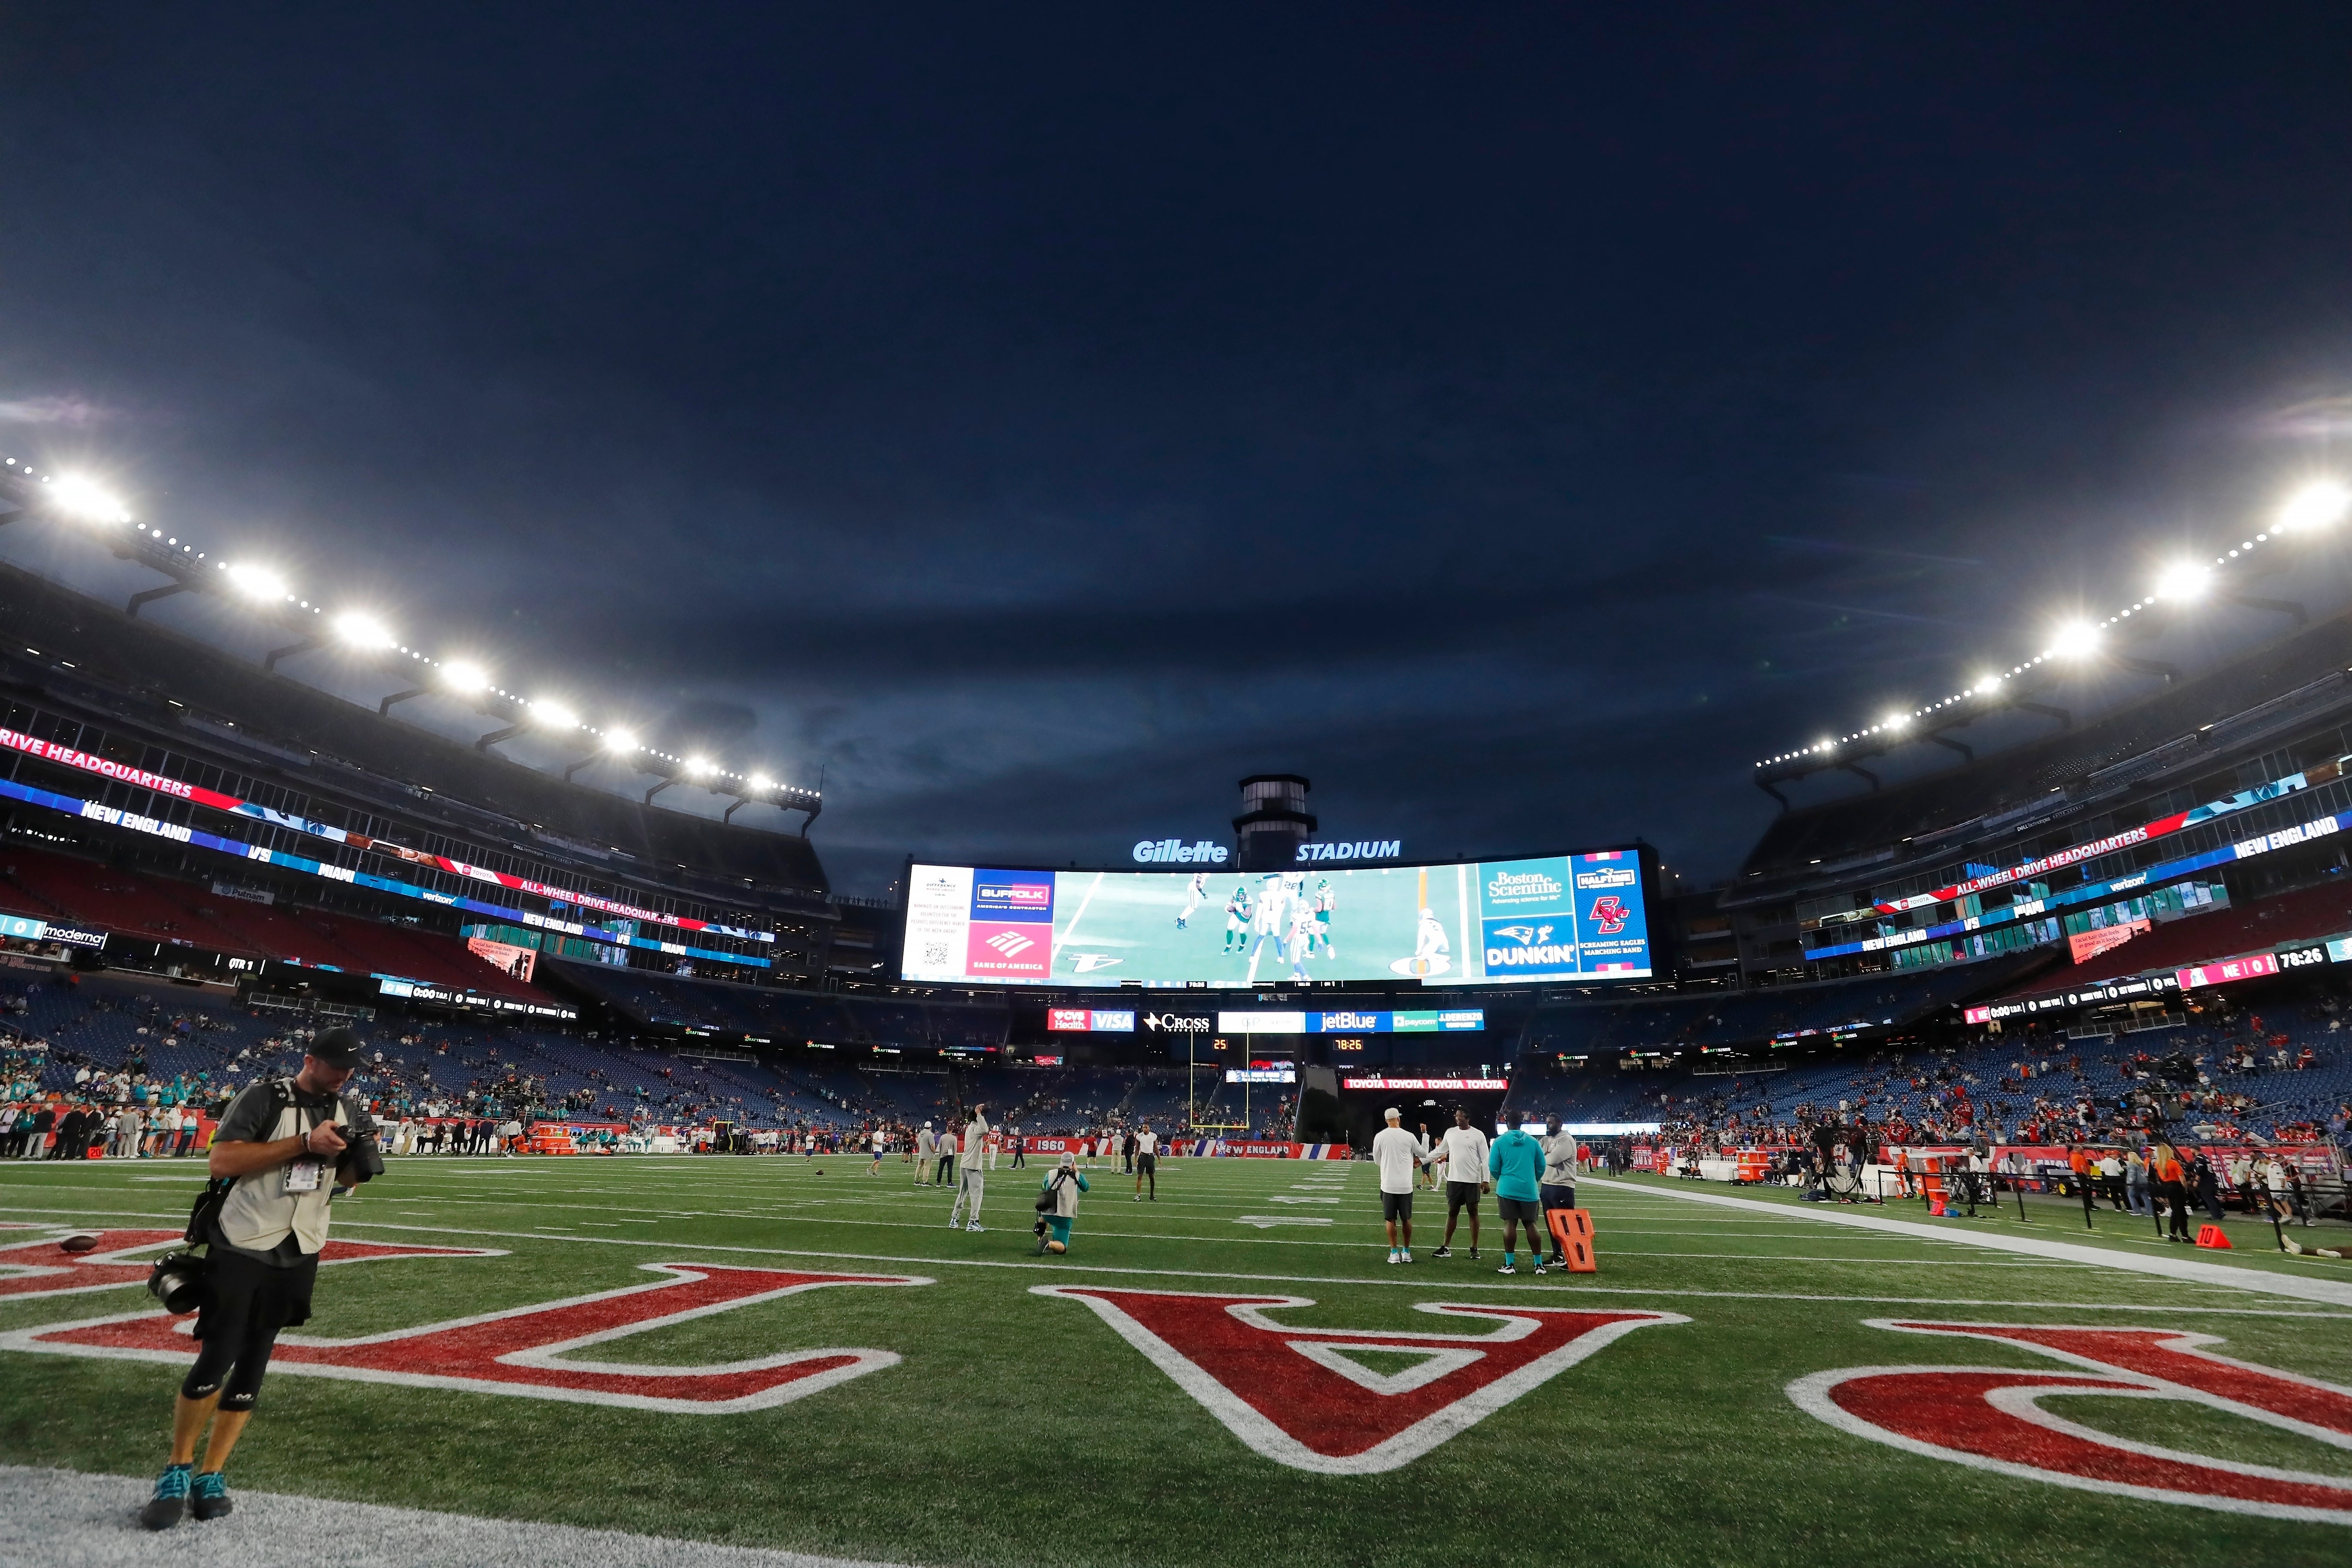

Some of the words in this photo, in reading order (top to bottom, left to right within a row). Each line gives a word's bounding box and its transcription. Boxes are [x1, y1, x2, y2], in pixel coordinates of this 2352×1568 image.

[0, 729, 45, 755] RIVE
[46, 744, 192, 798] HEADQUARTERS
[80, 802, 123, 824] NEW
[120, 812, 192, 842] ENGLAND
[2235, 839, 2269, 859] NEW
[2269, 816, 2340, 851] ENGLAND
[250, 845, 270, 862] VS
[1133, 839, 1228, 863] Gillette
[1295, 840, 1401, 861] STADIUM
[1957, 869, 2014, 896] ALL-WHEEL
[2015, 858, 2049, 879] DRIVE
[2049, 827, 2148, 868] HEADQUARTERS
[318, 863, 355, 883] MIAMI
[473, 870, 492, 879] TOYOTA
[1497, 872, 1543, 885] Boston
[1580, 873, 1631, 885] HALFTIME
[1488, 877, 1562, 897] Scientific
[2110, 877, 2143, 892] verizon
[232, 888, 265, 901] Putnam
[423, 891, 451, 905] verizon
[520, 880, 576, 903] ALL-WHEEL
[578, 894, 605, 910] DRIVE
[981, 889, 1043, 899] SUFFOLK
[1910, 897, 1929, 905] TOYOTA
[2014, 900, 2045, 919] MIAMI
[14, 921, 27, 934] 0
[44, 926, 101, 943] moderna
[523, 913, 545, 927] NEW
[544, 917, 584, 935] ENGLAND
[616, 934, 629, 944] VS
[661, 942, 686, 955] MIAMI
[1862, 938, 1886, 952] NEW
[1885, 930, 1927, 947] ENGLAND
[1964, 918, 1978, 931] VS
[1487, 945, 1575, 966] DUNKIN'
[2222, 963, 2240, 978] NE
[2252, 959, 2263, 973] 0
[2280, 948, 2323, 968] 78:26
[229, 958, 245, 969] QTR
[248, 961, 253, 970] 1
[413, 987, 435, 999] 0:00
[455, 994, 463, 1003] 0
[494, 1000, 502, 1009] 0
[528, 1005, 535, 1014] 0
[561, 1010, 567, 1018] 0
[1977, 1011, 1989, 1020] NE
[1991, 1005, 2010, 1018] 0:00
[2028, 1001, 2037, 1011] 0
[2068, 994, 2078, 1005] 0
[2108, 986, 2118, 998] 0
[2153, 978, 2163, 990] 0
[1064, 1012, 1085, 1020] CVS
[1093, 1014, 1132, 1029] VISA
[1161, 1014, 1210, 1029] CROSS
[1320, 1012, 1375, 1032] jetBlue
[1405, 1019, 1436, 1027] paycom
[1214, 1039, 1226, 1049] 25
[1335, 1039, 1362, 1050] 78:26
[1348, 1079, 1385, 1089] TOYOTA
[1387, 1079, 1424, 1089] TOYOTA
[1427, 1079, 1463, 1089] TOYOTA
[1466, 1079, 1504, 1089] TOYOTA
[90, 1148, 101, 1157] 20
[1037, 1140, 1065, 1151] 1960
[1246, 1145, 1289, 1155] ENGLAND
[2200, 1226, 2213, 1244] 10
